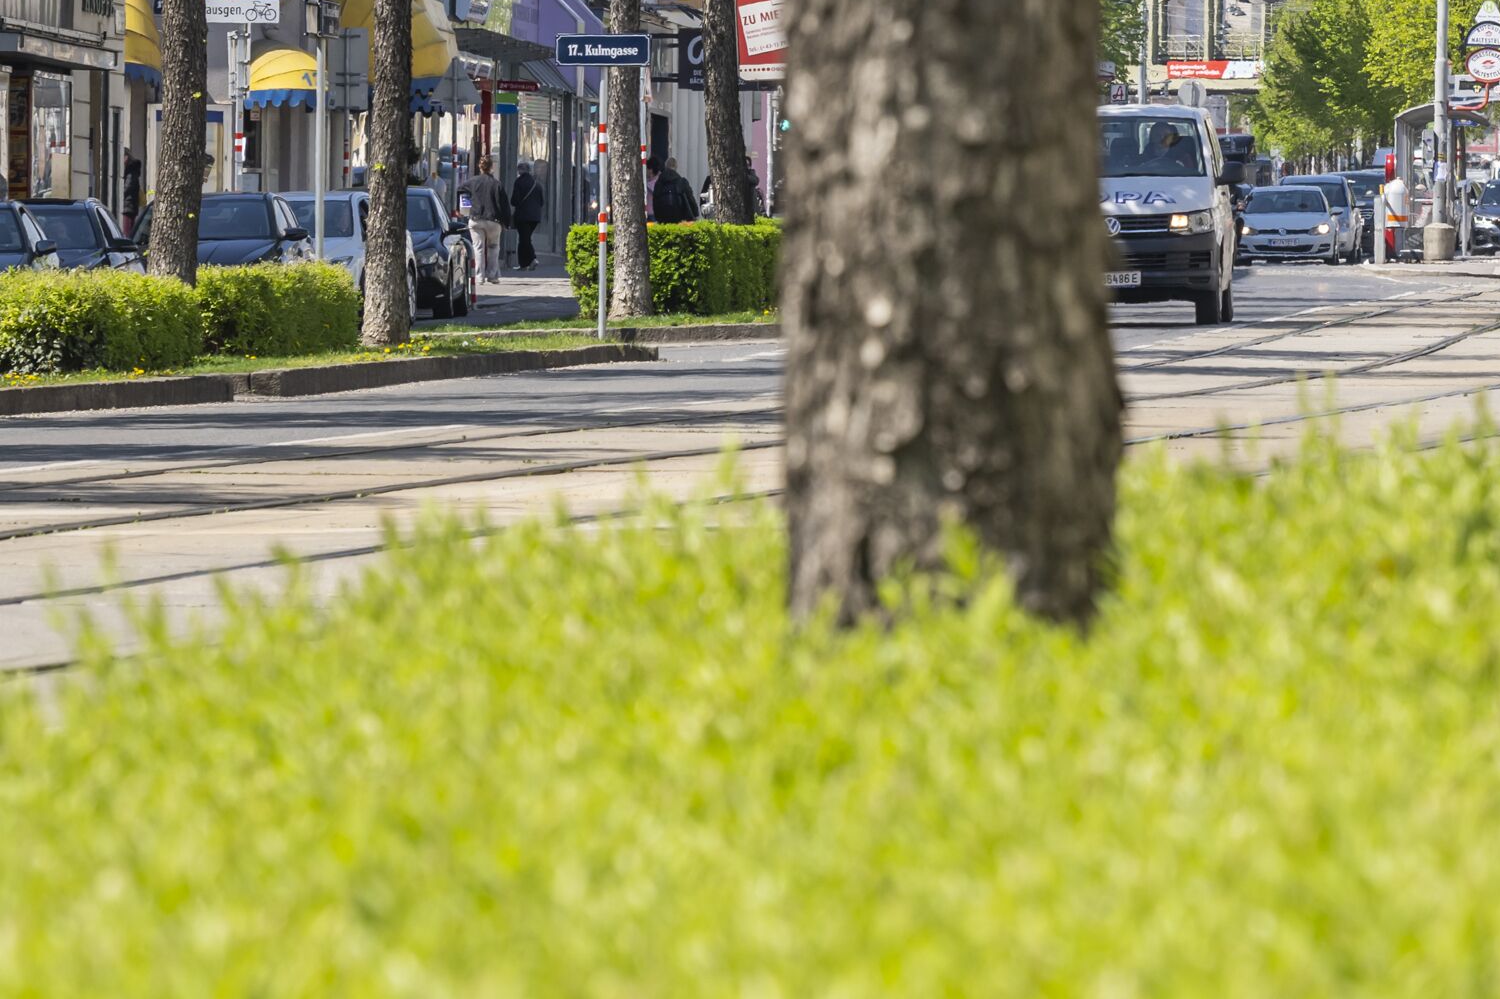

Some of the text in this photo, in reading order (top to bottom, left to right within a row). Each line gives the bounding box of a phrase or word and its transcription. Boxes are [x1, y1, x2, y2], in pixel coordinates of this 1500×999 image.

[206, 5, 246, 18] ausgen.
[742, 9, 784, 26] ZU MIE
[584, 44, 639, 59] Kulmgasse
